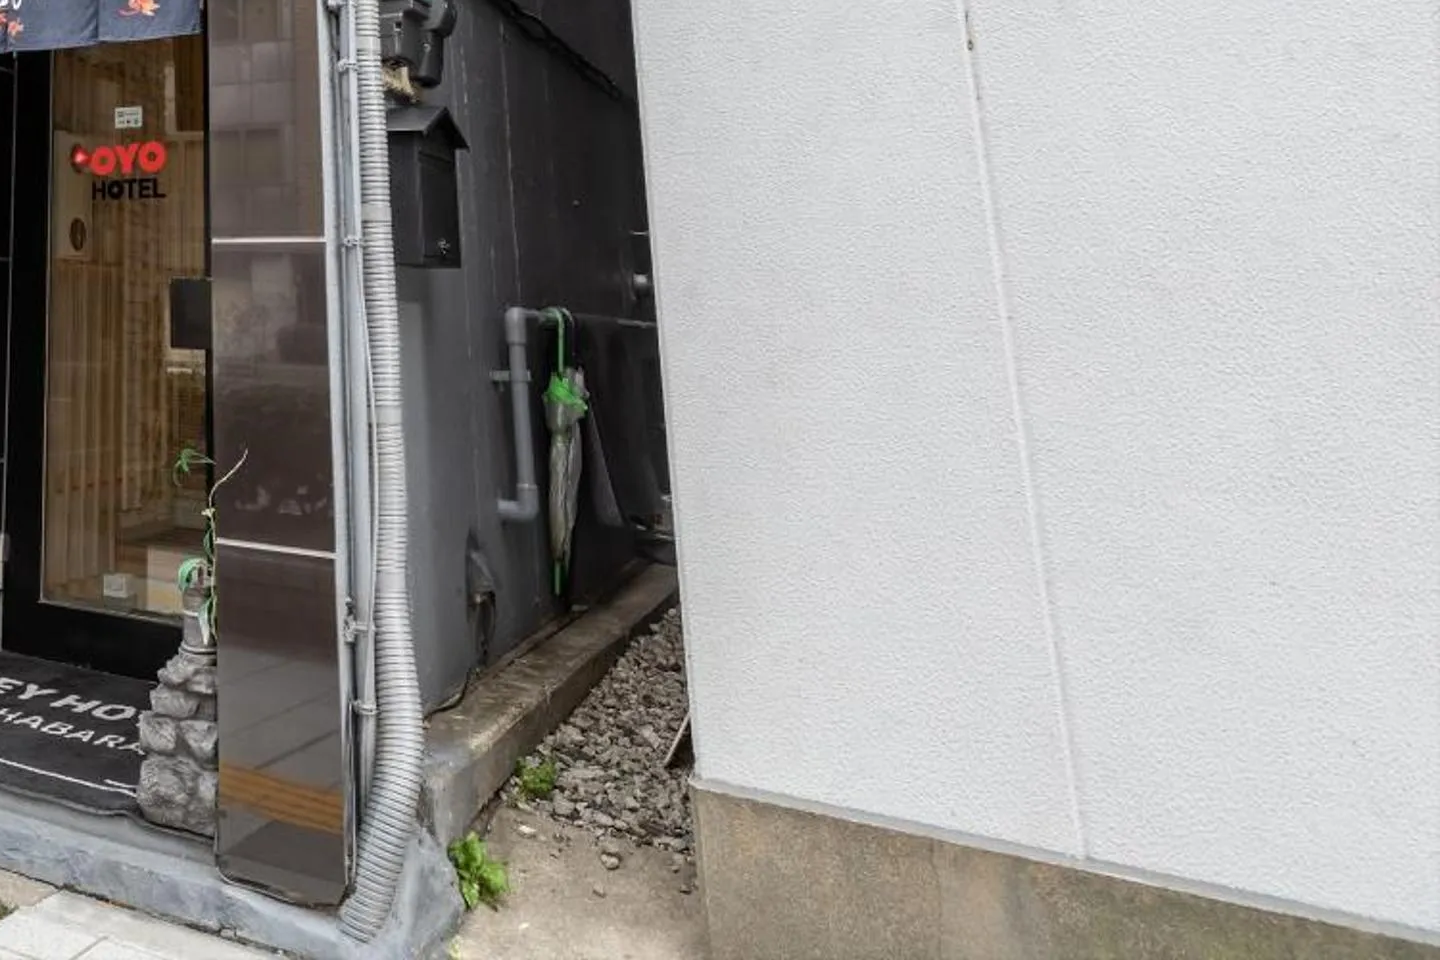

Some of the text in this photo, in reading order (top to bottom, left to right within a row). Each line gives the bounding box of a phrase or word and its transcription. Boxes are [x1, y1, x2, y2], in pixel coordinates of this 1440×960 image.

[91, 141, 167, 176] OYO
[92, 178, 167, 200] HOTEL
[50, 694, 137, 721] HO
